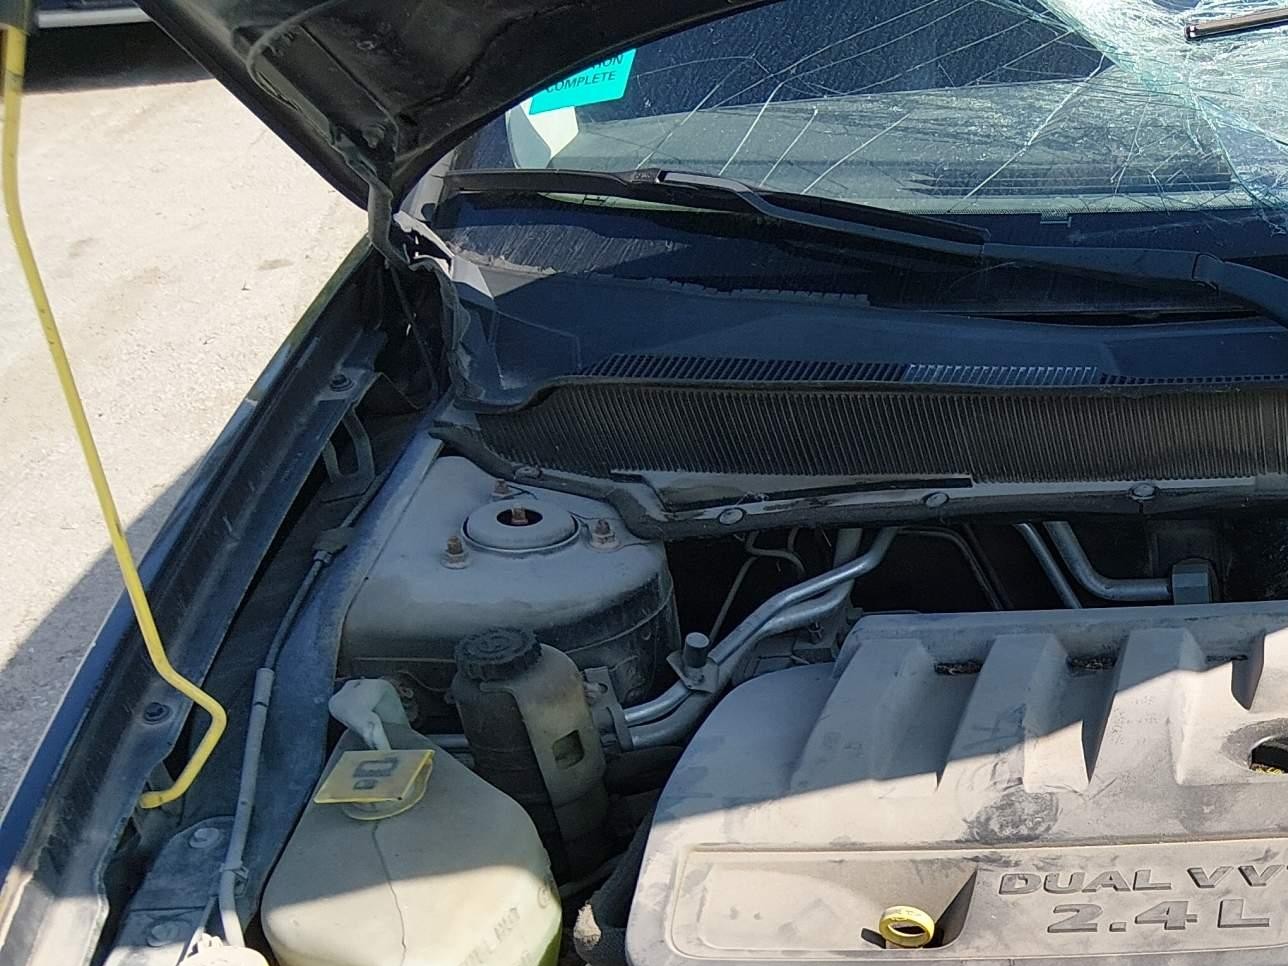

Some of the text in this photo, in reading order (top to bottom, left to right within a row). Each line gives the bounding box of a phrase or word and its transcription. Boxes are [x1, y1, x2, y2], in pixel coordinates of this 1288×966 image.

[999, 869, 1172, 895] DUAL
[1046, 898, 1271, 934] 2.4 L
